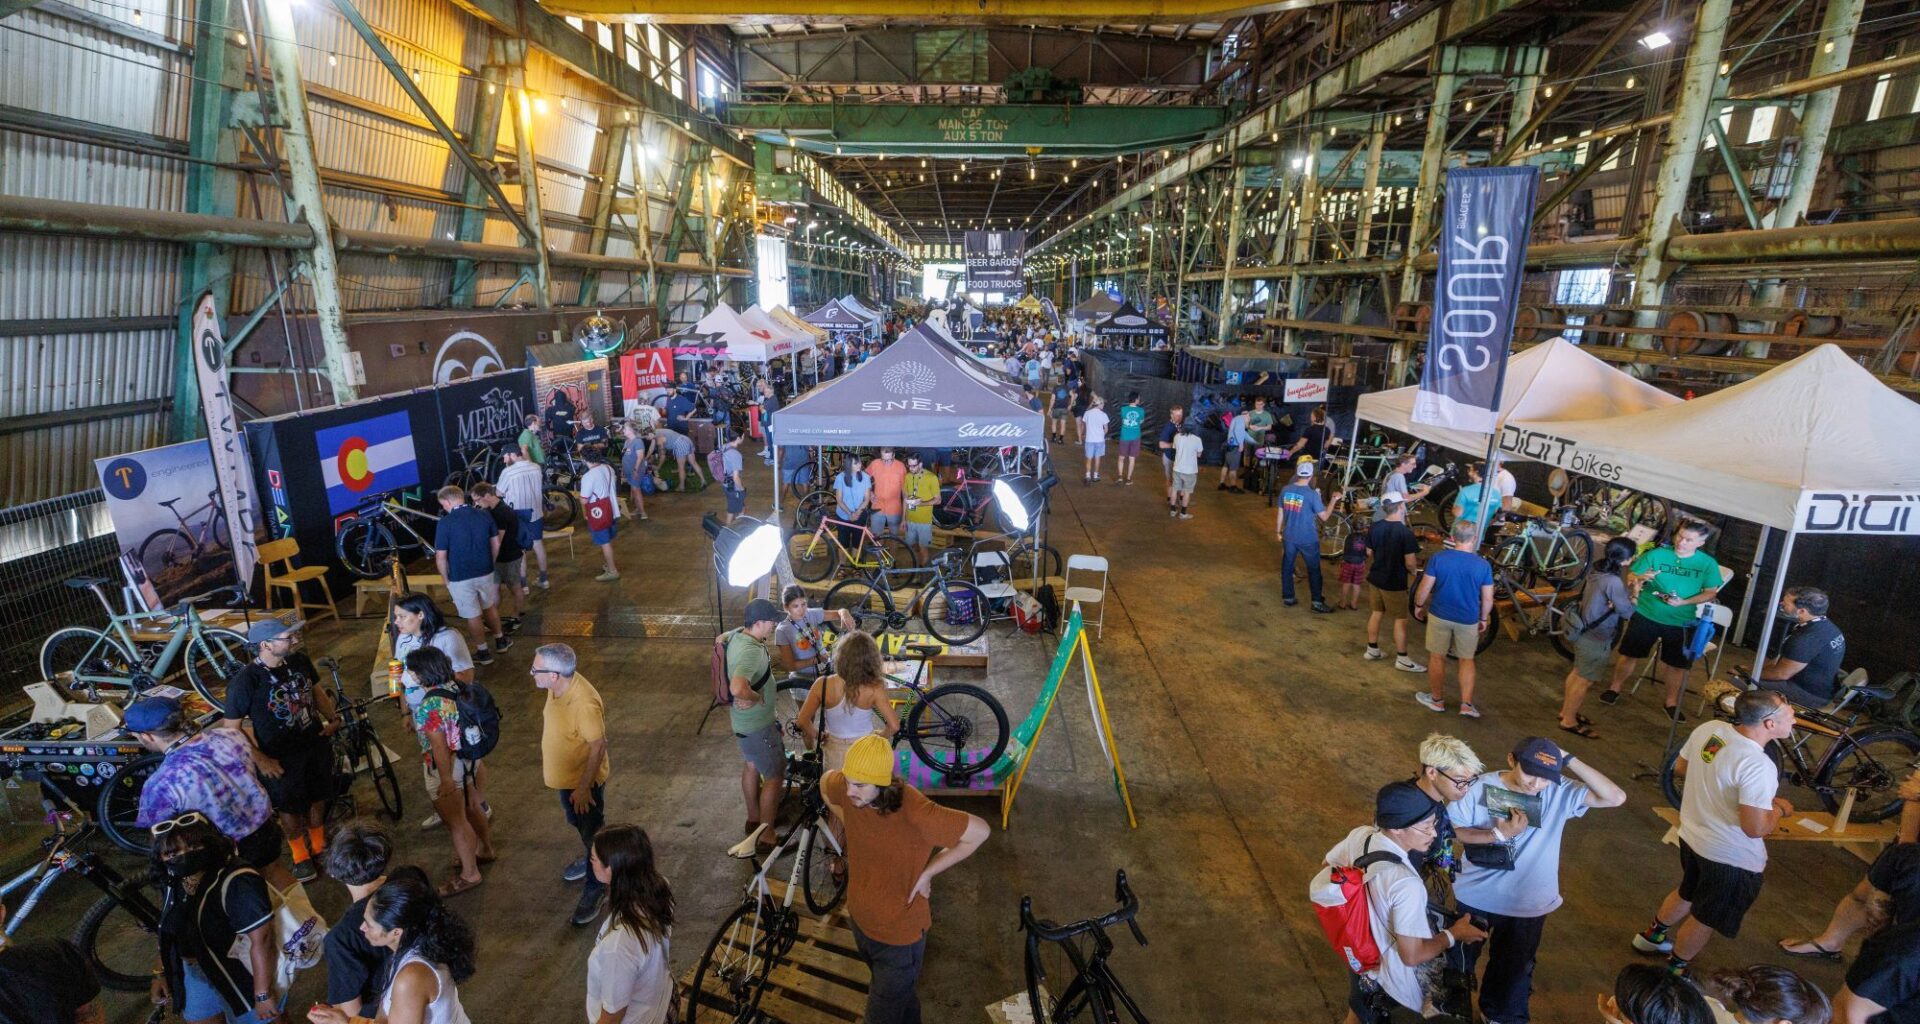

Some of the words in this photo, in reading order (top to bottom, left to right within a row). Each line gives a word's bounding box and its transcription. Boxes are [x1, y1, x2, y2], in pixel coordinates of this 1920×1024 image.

[961, 108, 985, 118] CAP
[938, 119, 966, 130] MAIN
[968, 119, 982, 130] 25
[986, 119, 1009, 130] TON
[943, 131, 966, 141] AUX
[969, 131, 977, 141] 5
[980, 131, 1003, 141] TON
[967, 258, 988, 267] BEER
[990, 258, 1023, 267] GARDEN
[968, 280, 989, 288] FOOD
[991, 279, 1022, 288] TRUCKS
[637, 373, 668, 387] OREGON
[456, 397, 527, 444] MERLIN
[1570, 450, 1623, 481] bikes
